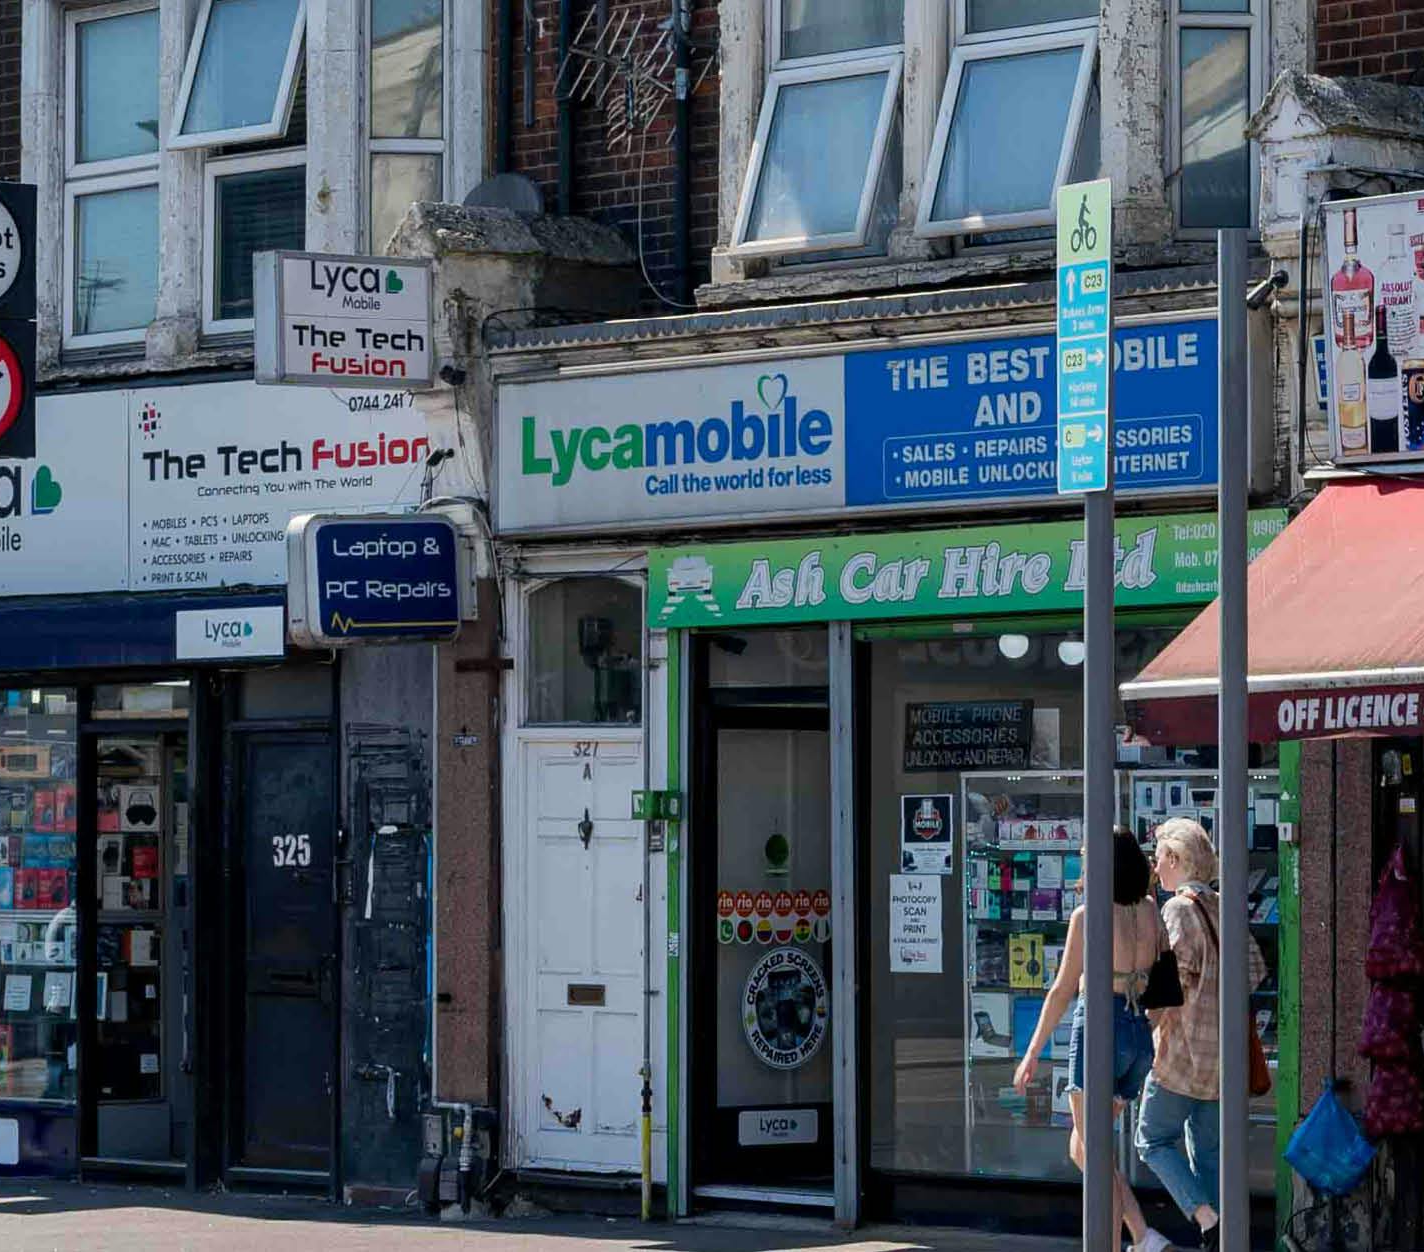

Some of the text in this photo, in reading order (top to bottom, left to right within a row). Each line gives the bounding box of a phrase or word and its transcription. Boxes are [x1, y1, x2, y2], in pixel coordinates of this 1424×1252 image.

[310, 260, 381, 298] Lyca
[1084, 275, 1102, 289] C23
[342, 297, 381, 310] Mobile
[292, 325, 424, 351] The Tech
[312, 352, 406, 377] Fusion
[886, 347, 1050, 392] THE BEST
[1065, 353, 1083, 368] C23
[349, 396, 379, 412] 0744
[974, 392, 1042, 427] AND
[522, 396, 833, 487] Lycamobile
[902, 436, 1047, 463] SALES REPAIRS
[142, 433, 429, 480] The Tech Fusion
[198, 475, 373, 497] Connecting You with The World
[645, 465, 832, 495] Call the world for less
[905, 467, 969, 489] MOBILE
[151, 517, 187, 529] MOBILES
[232, 513, 269, 525] LAPTOPS
[151, 531, 284, 547] MAC TABLETS UNLOCKING
[333, 537, 440, 560] Laptop &
[151, 550, 253, 566] ACCESSORIES REPAIRS
[151, 573, 174, 584] PRINT
[184, 571, 208, 583] SCAN
[735, 550, 827, 609] Ash
[839, 551, 931, 604] Car
[938, 541, 1052, 598] Hire
[326, 580, 452, 601] PC Repairs
[205, 619, 241, 642] Lyca
[912, 705, 1021, 724] MOBILE PHONE
[1278, 698, 1319, 732] OFF
[1324, 693, 1419, 730] LICENCE
[913, 727, 1018, 745] ACCESSORIES
[573, 741, 599, 758] 327
[582, 763, 592, 780] A
[272, 834, 311, 868] 325
[718, 894, 733, 908] ria
[737, 894, 753, 908] ria
[758, 894, 772, 909] ria
[795, 893, 810, 906] ria
[892, 895, 937, 904] PHOTOCOPY
[903, 906, 927, 916] SCAN
[903, 924, 927, 935] PRINT
[746, 952, 825, 1005] CRACKED SCREENS
[751, 1023, 823, 1064] REPAIRED HERE
[759, 1117, 789, 1133] Lyca
